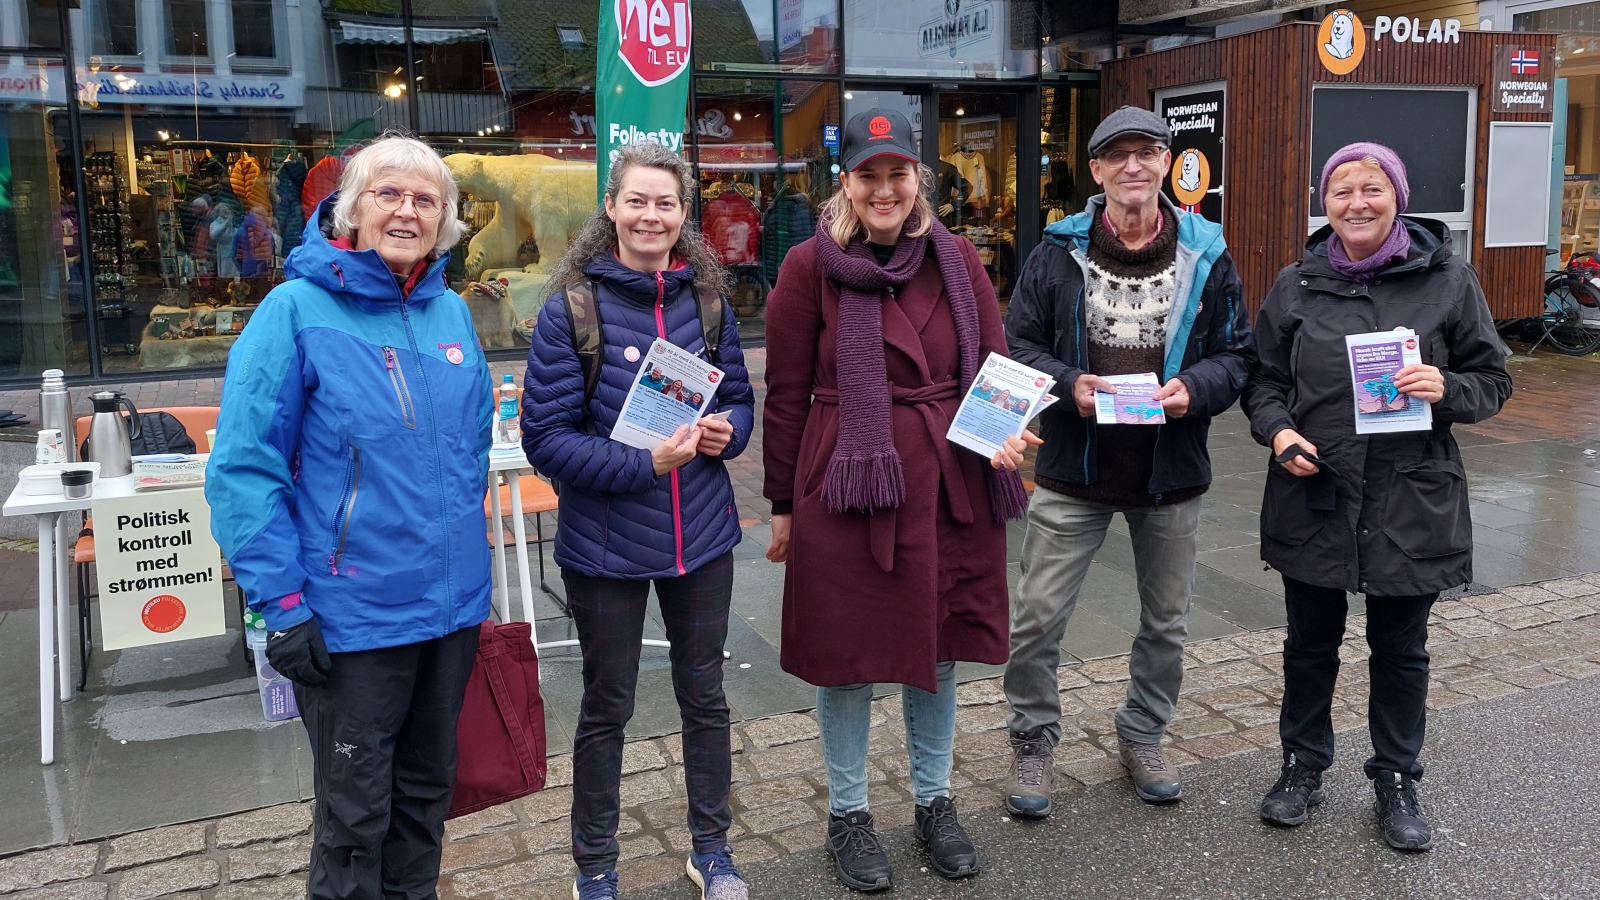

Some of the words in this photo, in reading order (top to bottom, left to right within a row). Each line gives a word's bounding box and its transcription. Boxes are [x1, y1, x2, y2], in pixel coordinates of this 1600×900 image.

[622, 0, 687, 47] nei
[1374, 16, 1460, 44] POLAR
[666, 50, 687, 66] EU
[1500, 81, 1547, 91] NORWEGIAN
[1167, 102, 1218, 117] NORWEGIAN
[1501, 92, 1545, 108] Specialty
[1169, 114, 1215, 136] Specialty
[117, 509, 190, 530] Politisk
[118, 530, 192, 552] kontroll
[136, 553, 178, 572] med
[108, 567, 213, 594] strømmen!
